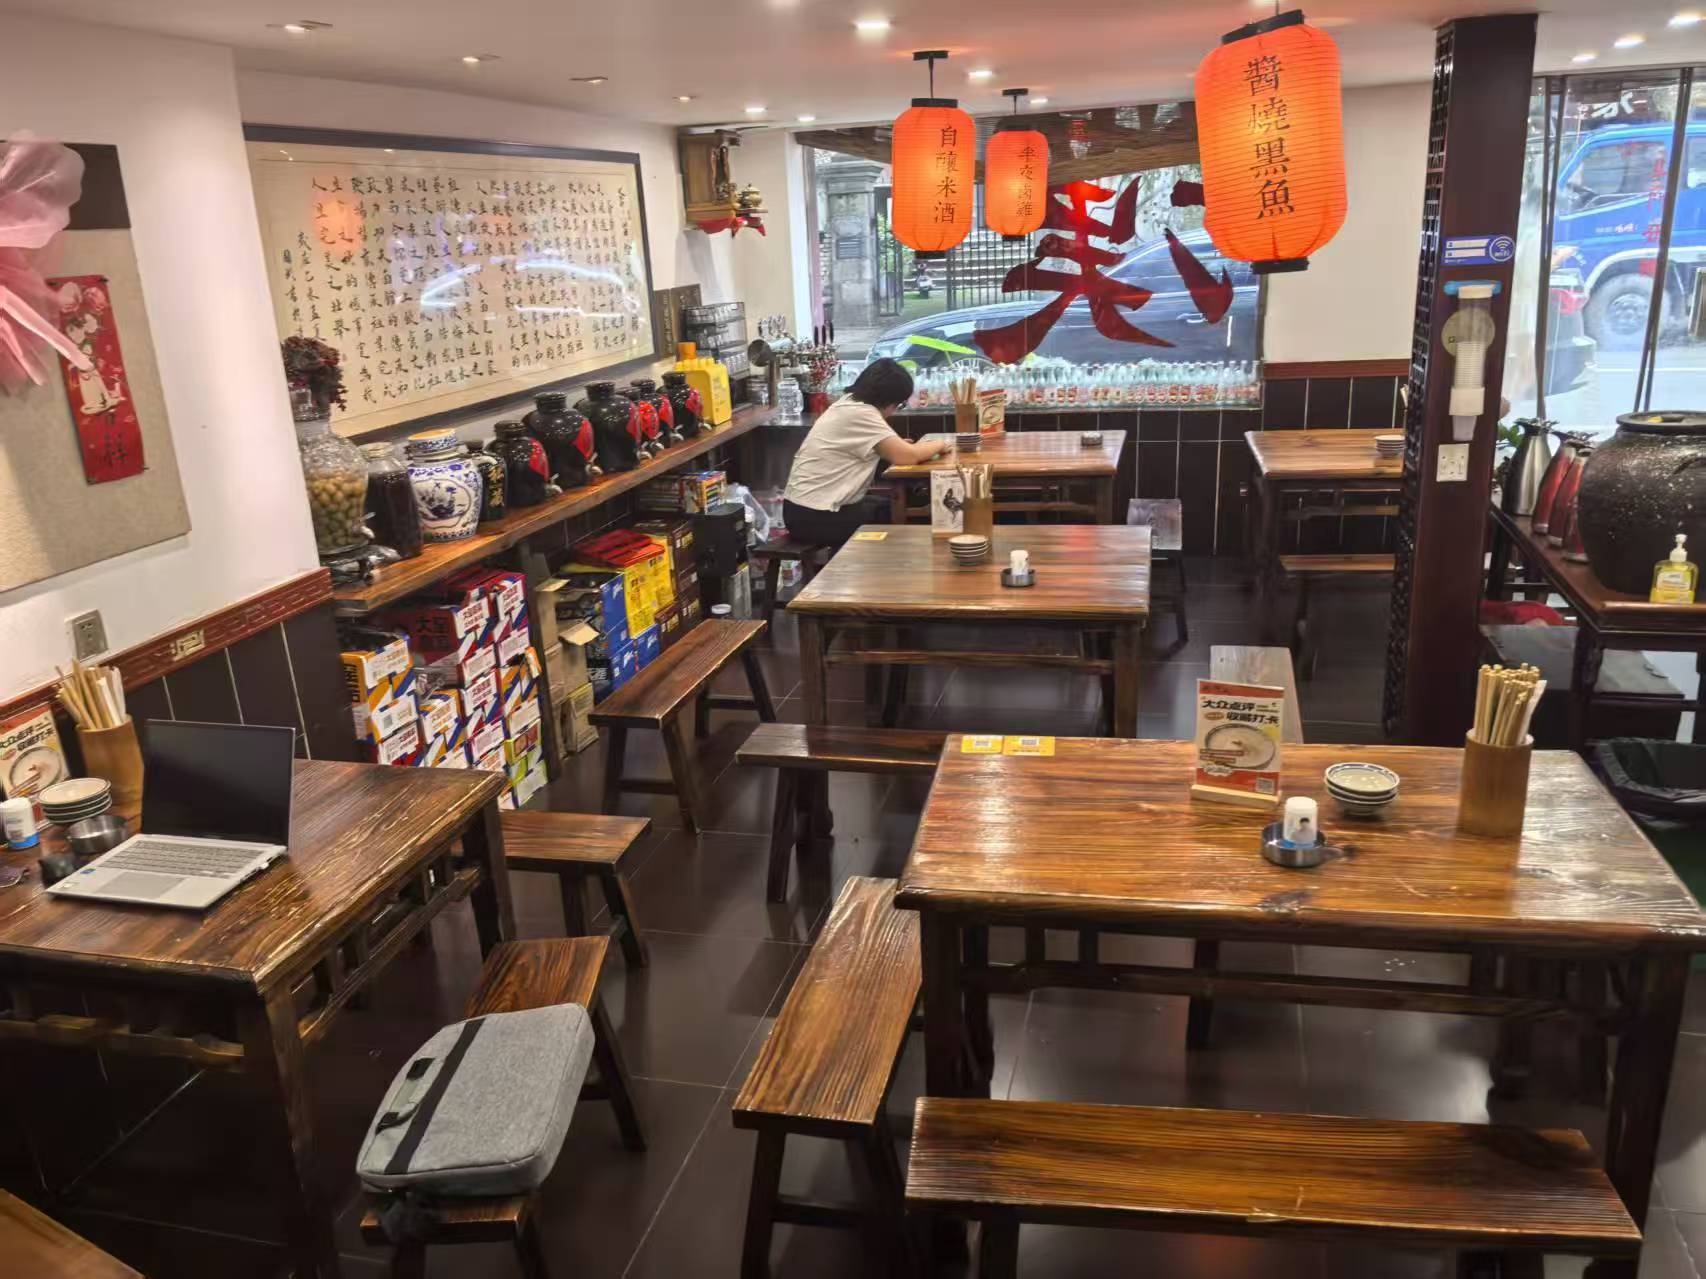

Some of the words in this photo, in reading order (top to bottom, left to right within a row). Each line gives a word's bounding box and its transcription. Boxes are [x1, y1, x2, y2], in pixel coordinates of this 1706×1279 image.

[934, 125, 960, 224] 自釀米酒
[1243, 55, 1295, 219] 醬燒黑魚
[1202, 699, 1256, 712] 大众点评
